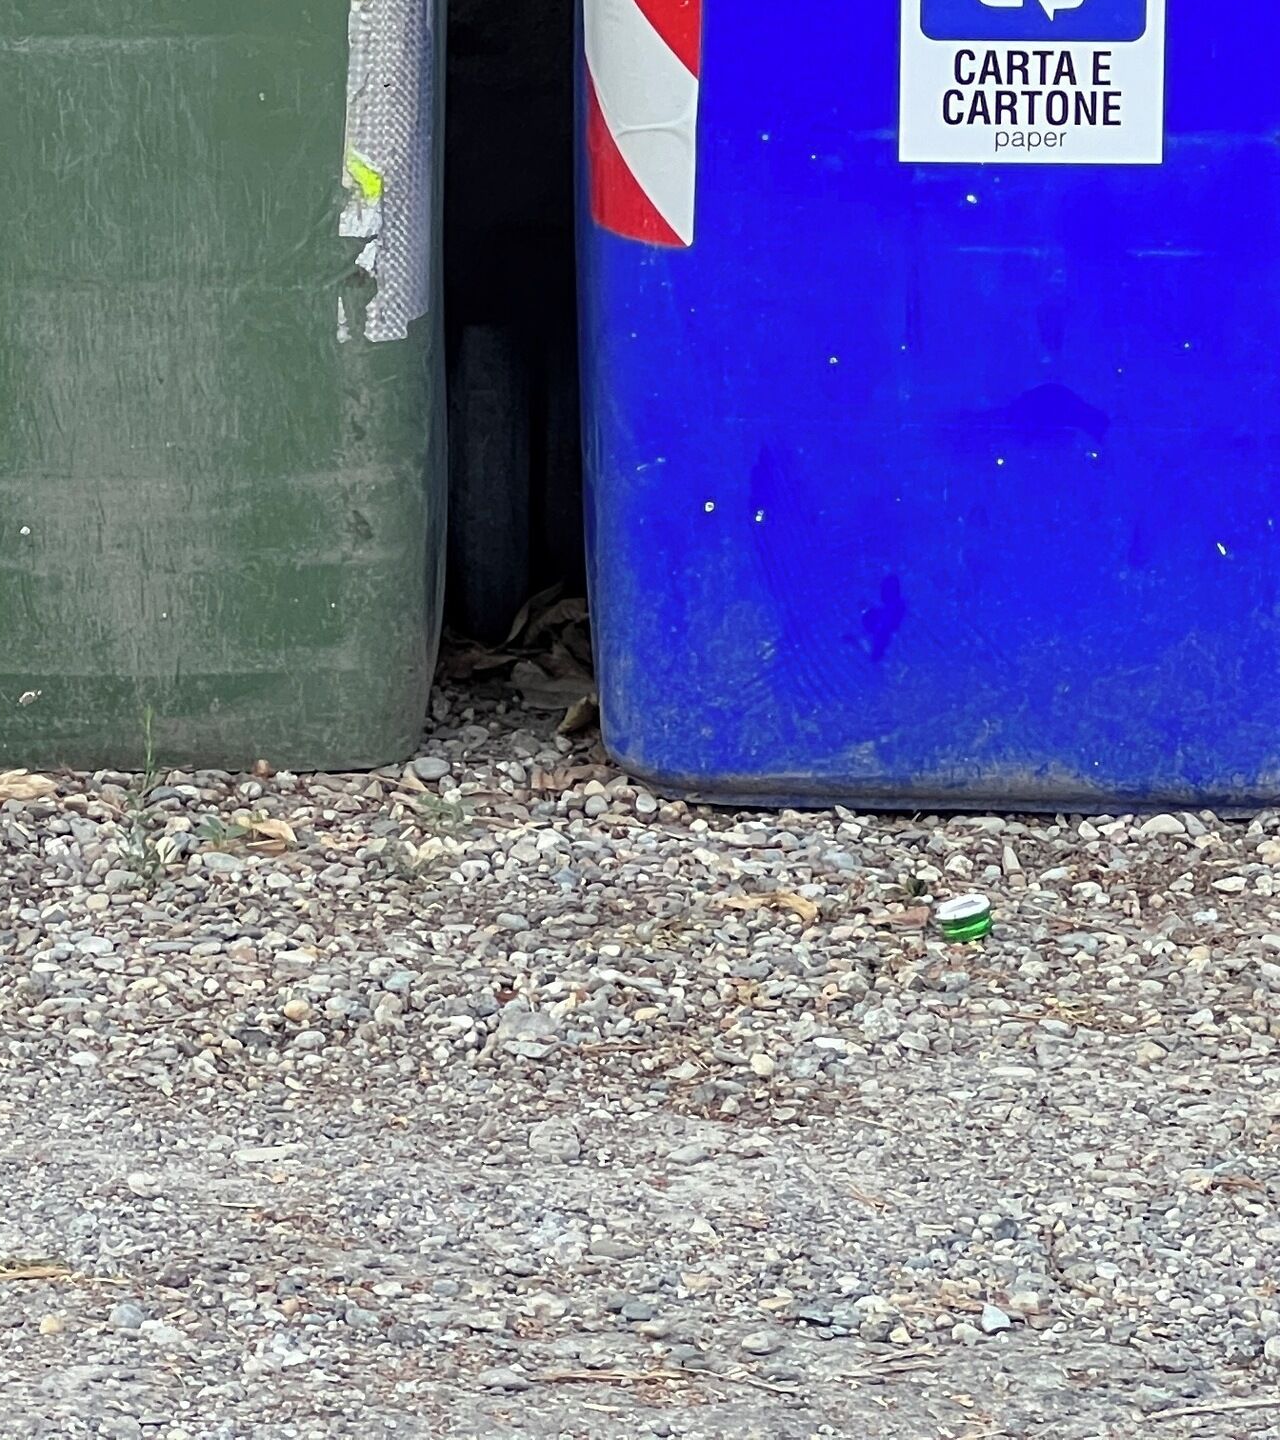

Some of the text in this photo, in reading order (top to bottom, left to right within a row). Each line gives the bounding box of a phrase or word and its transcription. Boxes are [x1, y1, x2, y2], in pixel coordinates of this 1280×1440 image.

[953, 49, 1112, 86] CARTA E
[942, 89, 1122, 126] CARTONE
[994, 130, 1067, 153] paper
